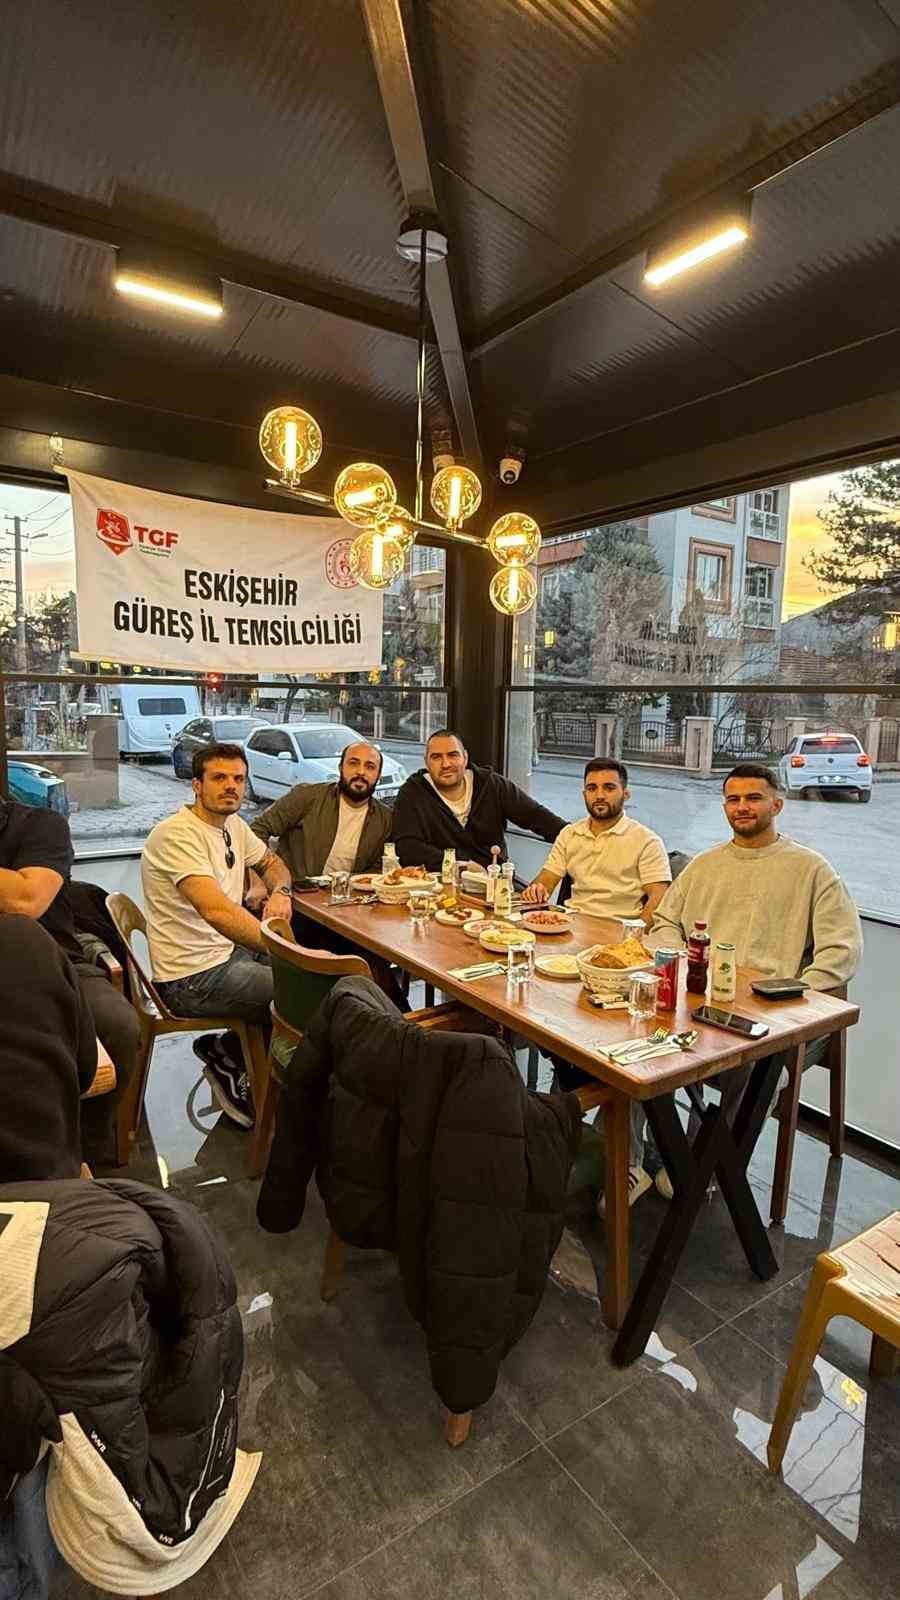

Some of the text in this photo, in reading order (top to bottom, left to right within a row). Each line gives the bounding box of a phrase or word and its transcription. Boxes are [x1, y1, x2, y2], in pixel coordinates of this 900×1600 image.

[134, 525, 179, 548] TGF
[184, 568, 298, 608] ESKİŞEHİR
[113, 597, 361, 646] GÜREŞ İL TEMSİLCİLİĞİ
